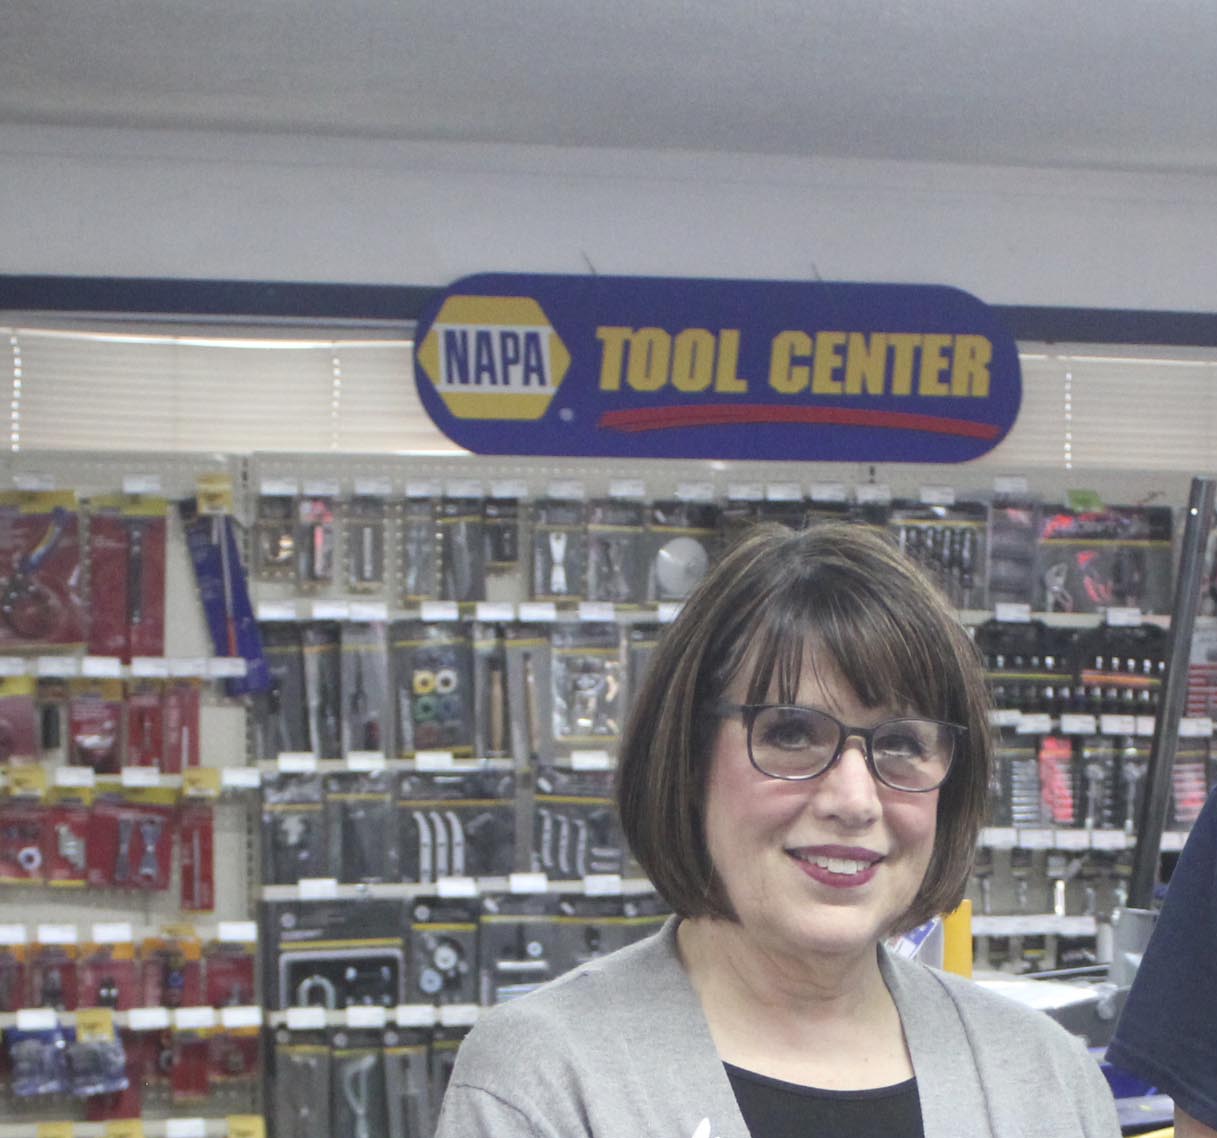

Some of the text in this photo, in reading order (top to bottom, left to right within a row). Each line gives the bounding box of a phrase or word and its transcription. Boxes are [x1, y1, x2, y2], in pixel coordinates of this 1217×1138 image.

[443, 328, 548, 388] NAPA
[596, 326, 994, 397] TOOL CENTER
